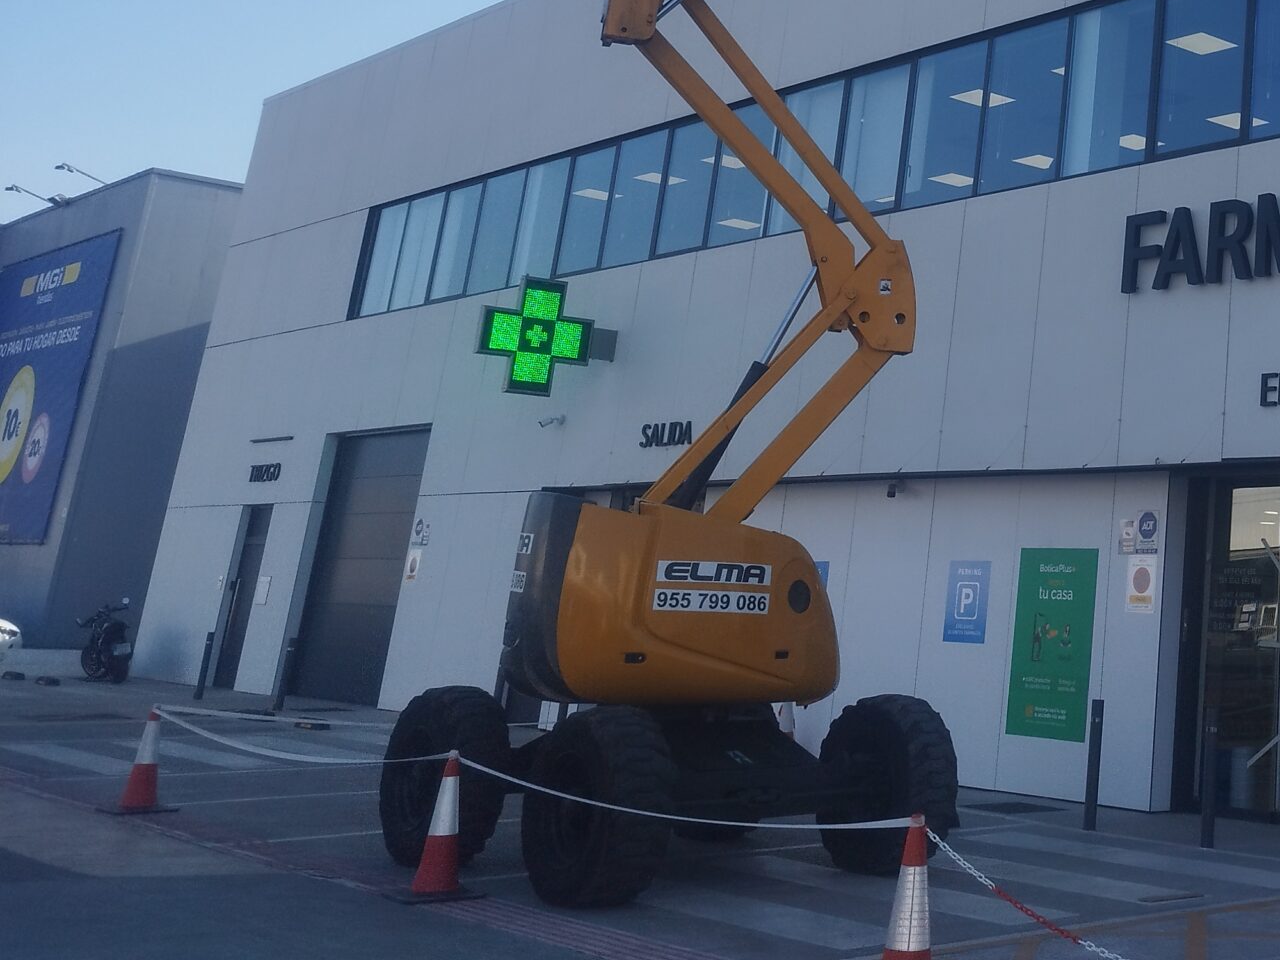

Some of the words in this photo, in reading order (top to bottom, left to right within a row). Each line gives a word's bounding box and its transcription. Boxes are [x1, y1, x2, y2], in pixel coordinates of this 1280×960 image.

[56, 326, 82, 345] DESDE
[639, 420, 693, 449] SALIDA
[664, 561, 766, 584] ELMA
[656, 591, 691, 609] 955
[697, 593, 731, 610] 799
[736, 594, 767, 612] 086
[960, 588, 974, 613] P
[1039, 586, 1049, 600] tu
[1051, 589, 1073, 601] casa
